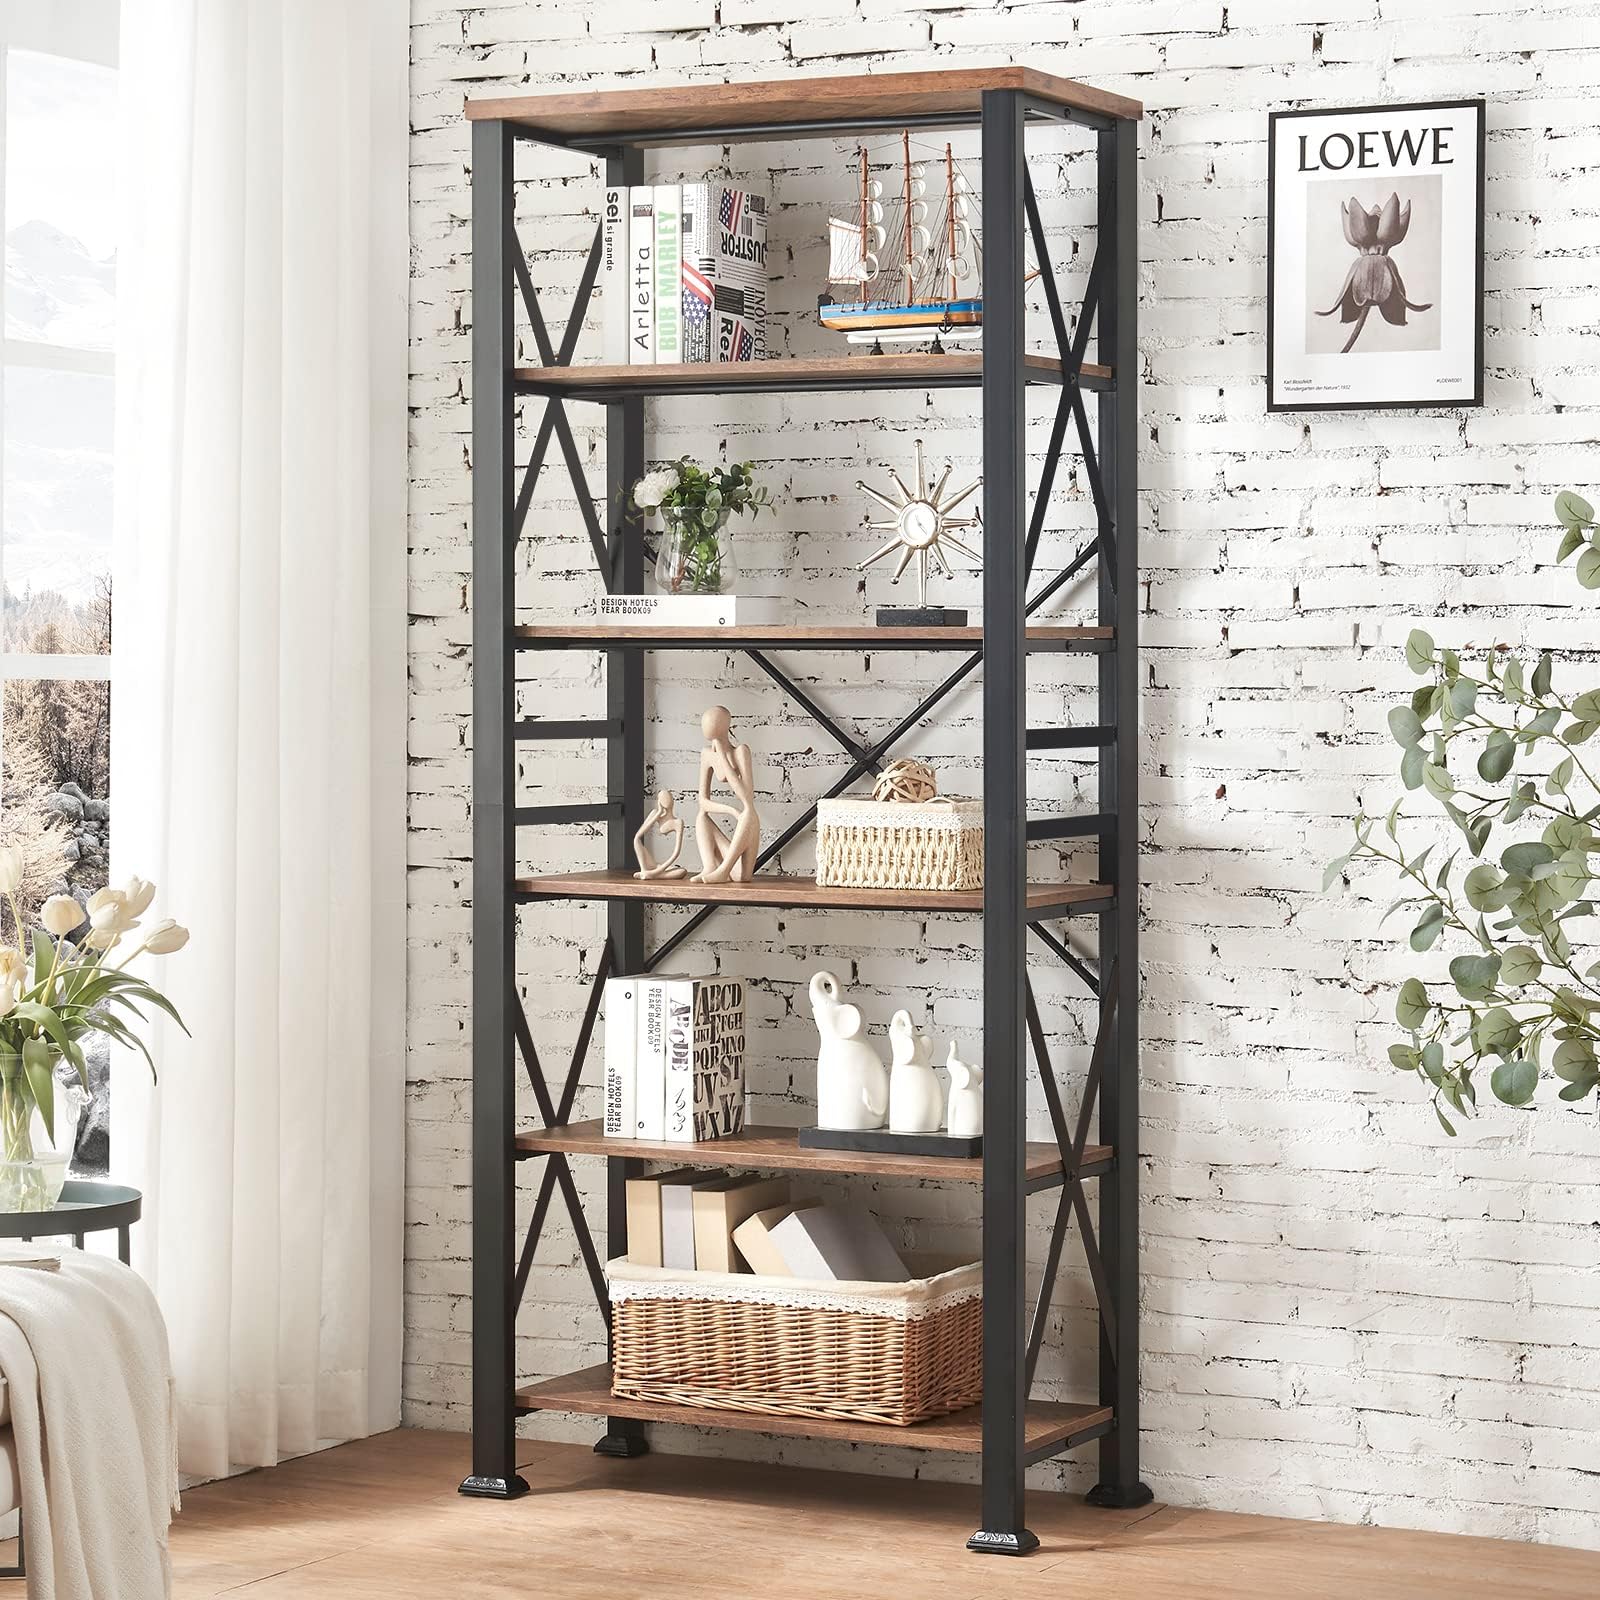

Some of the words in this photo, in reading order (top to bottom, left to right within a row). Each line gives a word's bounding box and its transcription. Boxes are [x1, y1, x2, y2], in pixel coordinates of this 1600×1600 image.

[1298, 127, 1454, 172] LOEWE
[606, 191, 622, 223] sei
[658, 210, 677, 297] MARLEY
[633, 246, 650, 350] Arletta
[659, 304, 677, 351] BOB
[601, 598, 628, 607] DESIGN
[630, 599, 658, 607] HOTELS
[601, 606, 620, 614] YEAR
[622, 606, 651, 614] BOOK09
[647, 1012, 655, 1045] BOOK09
[720, 1034, 745, 1055] MNO
[607, 1102, 615, 1132] DESIGN
[614, 1111, 622, 1132] YEAR
